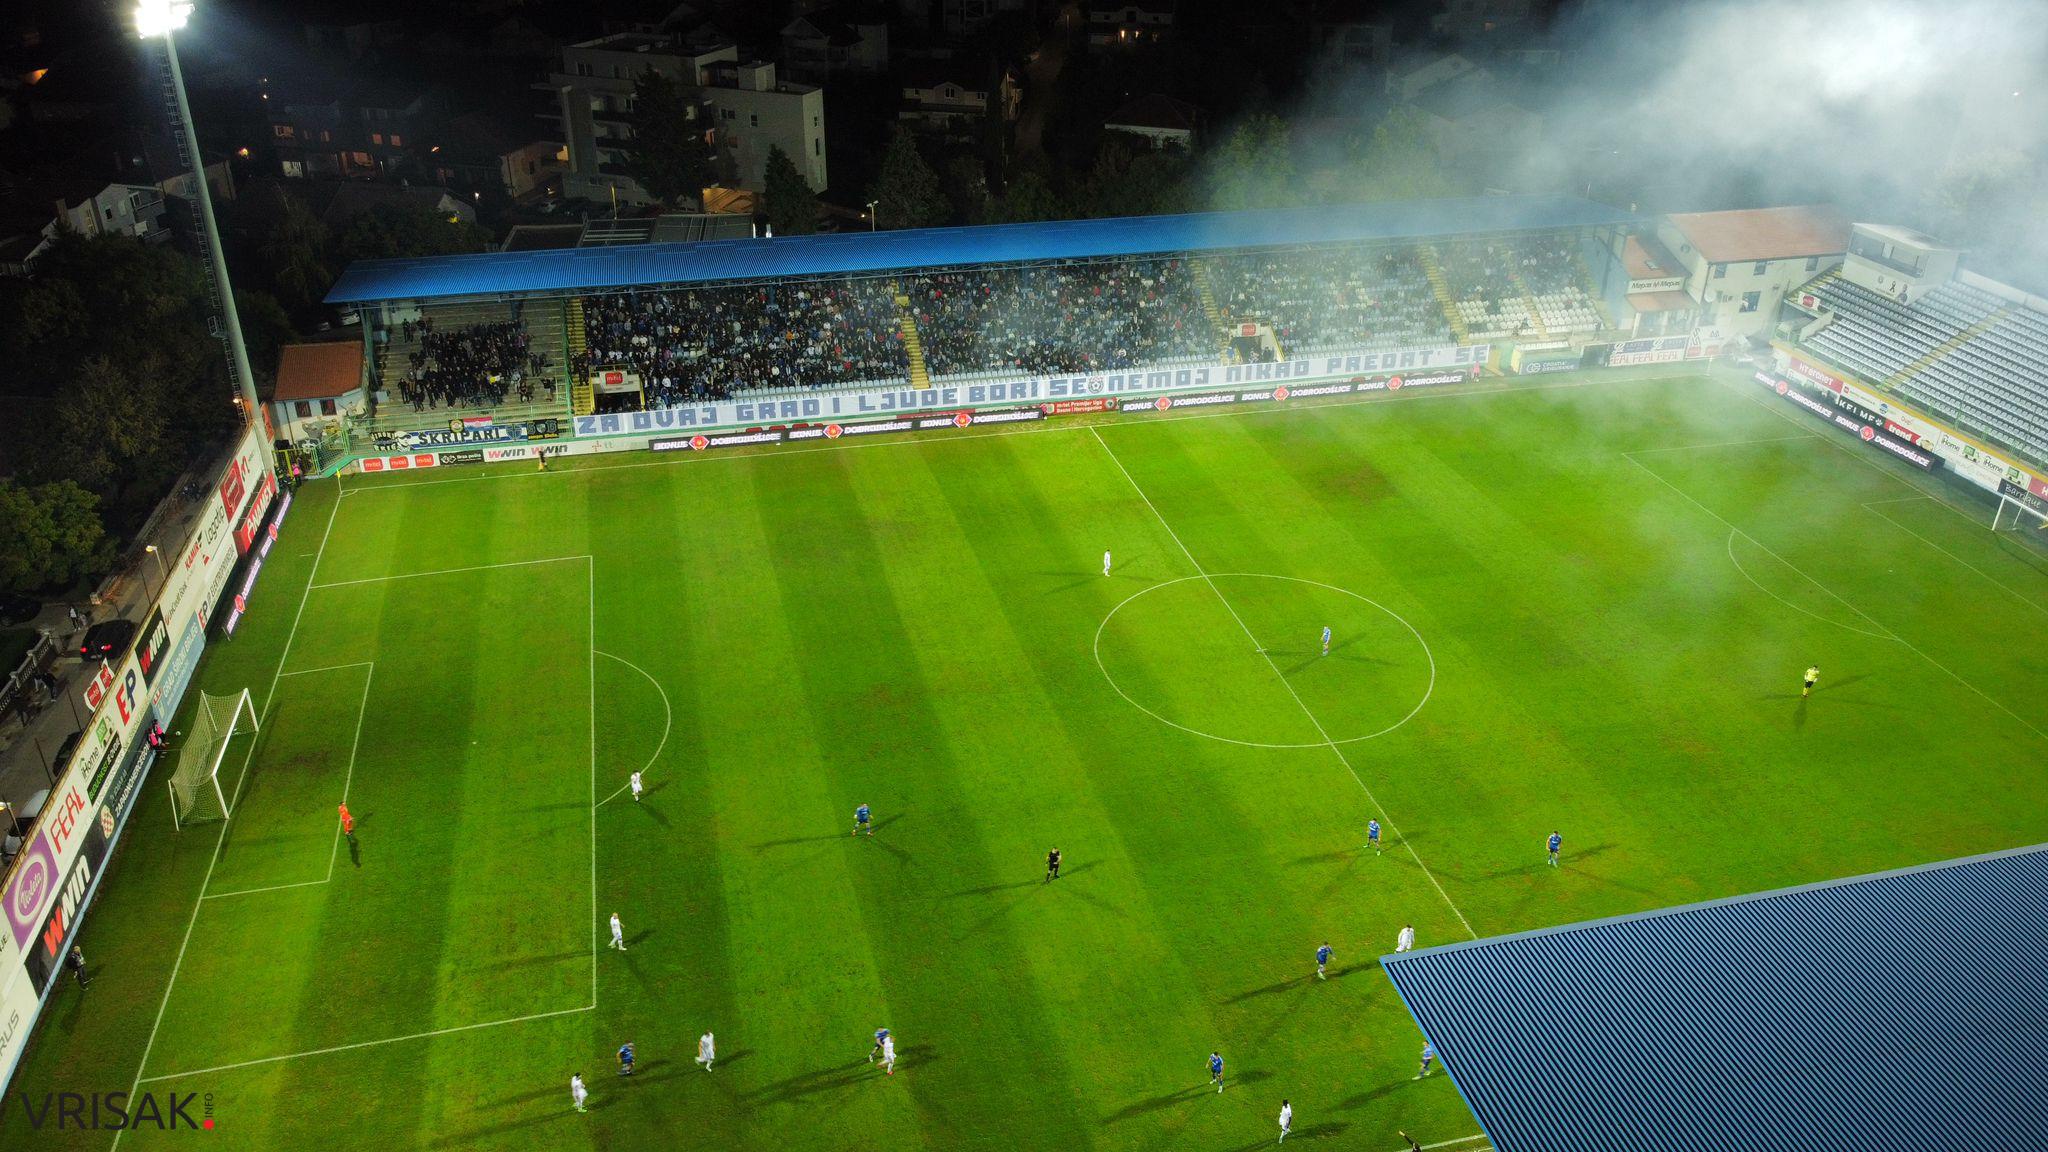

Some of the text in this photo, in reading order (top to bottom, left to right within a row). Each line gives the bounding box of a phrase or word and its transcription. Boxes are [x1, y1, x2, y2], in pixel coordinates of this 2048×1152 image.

[577, 414, 619, 434] ZA
[632, 407, 718, 429] OVAJ
[736, 399, 820, 421] GRAD
[832, 397, 840, 413] I
[858, 388, 958, 411] LJUDE
[969, 382, 1038, 402] BORI
[1050, 378, 1087, 395] SE
[1108, 369, 1209, 391] NEMOJ
[1226, 361, 1310, 382] NIKAD
[1456, 347, 1487, 362] SE
[1123, 375, 1462, 412] BONUS DOBRODOŠLICE BONUS DOBRODOŠLICE BONUS DOBRODOŠLICE
[419, 427, 500, 445] ŠKRIPARI
[1835, 415, 1860, 432] BONUS
[1874, 435, 1930, 467] DOBRODOŠLICE
[1888, 424, 1913, 442] trend
[116, 668, 136, 727] EP
[50, 785, 85, 854] FEAL
